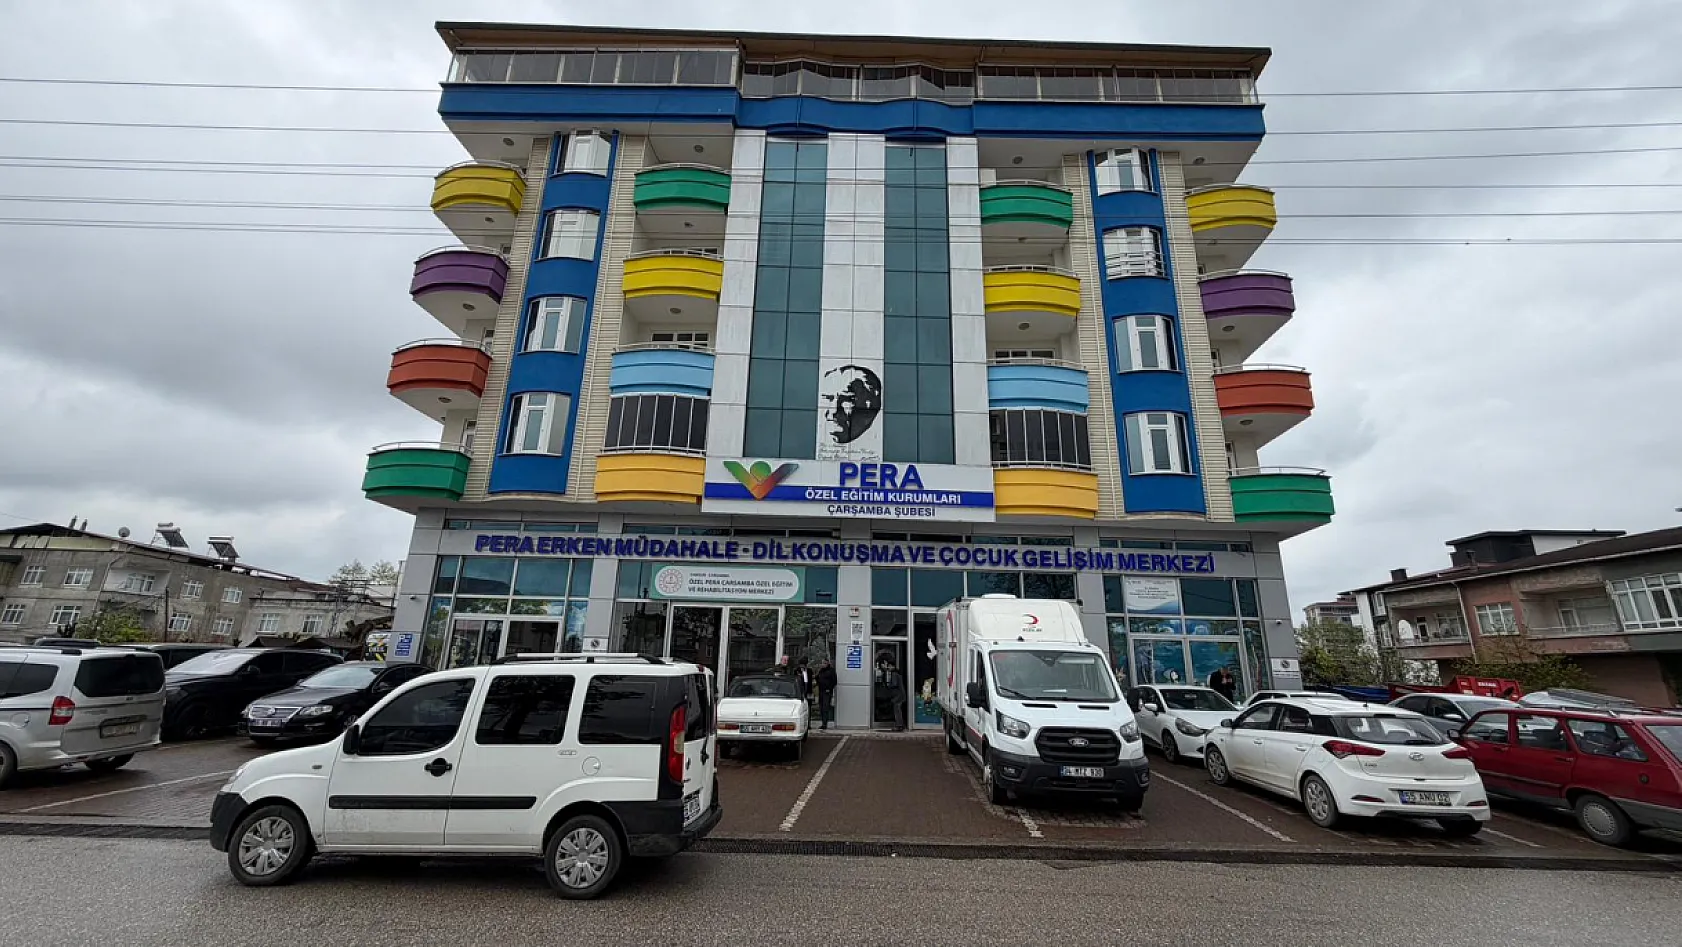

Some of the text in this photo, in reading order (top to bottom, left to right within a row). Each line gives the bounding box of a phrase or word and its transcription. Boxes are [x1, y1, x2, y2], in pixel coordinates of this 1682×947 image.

[839, 461, 925, 490] PERA
[804, 487, 961, 505] ÖZEL EĞİTİM KURUMLARI
[827, 504, 892, 516] ÇARŞAMBA
[475, 534, 534, 554] PERA
[536, 536, 612, 556] ERKEN
[614, 535, 740, 560] MÜDAHALE
[752, 537, 790, 560] DİL
[907, 546, 936, 563] VE
[938, 546, 1019, 566] ÇOCUK
[1021, 548, 1114, 570] GELİŞİM
[1118, 551, 1215, 573] MERKEZİ
